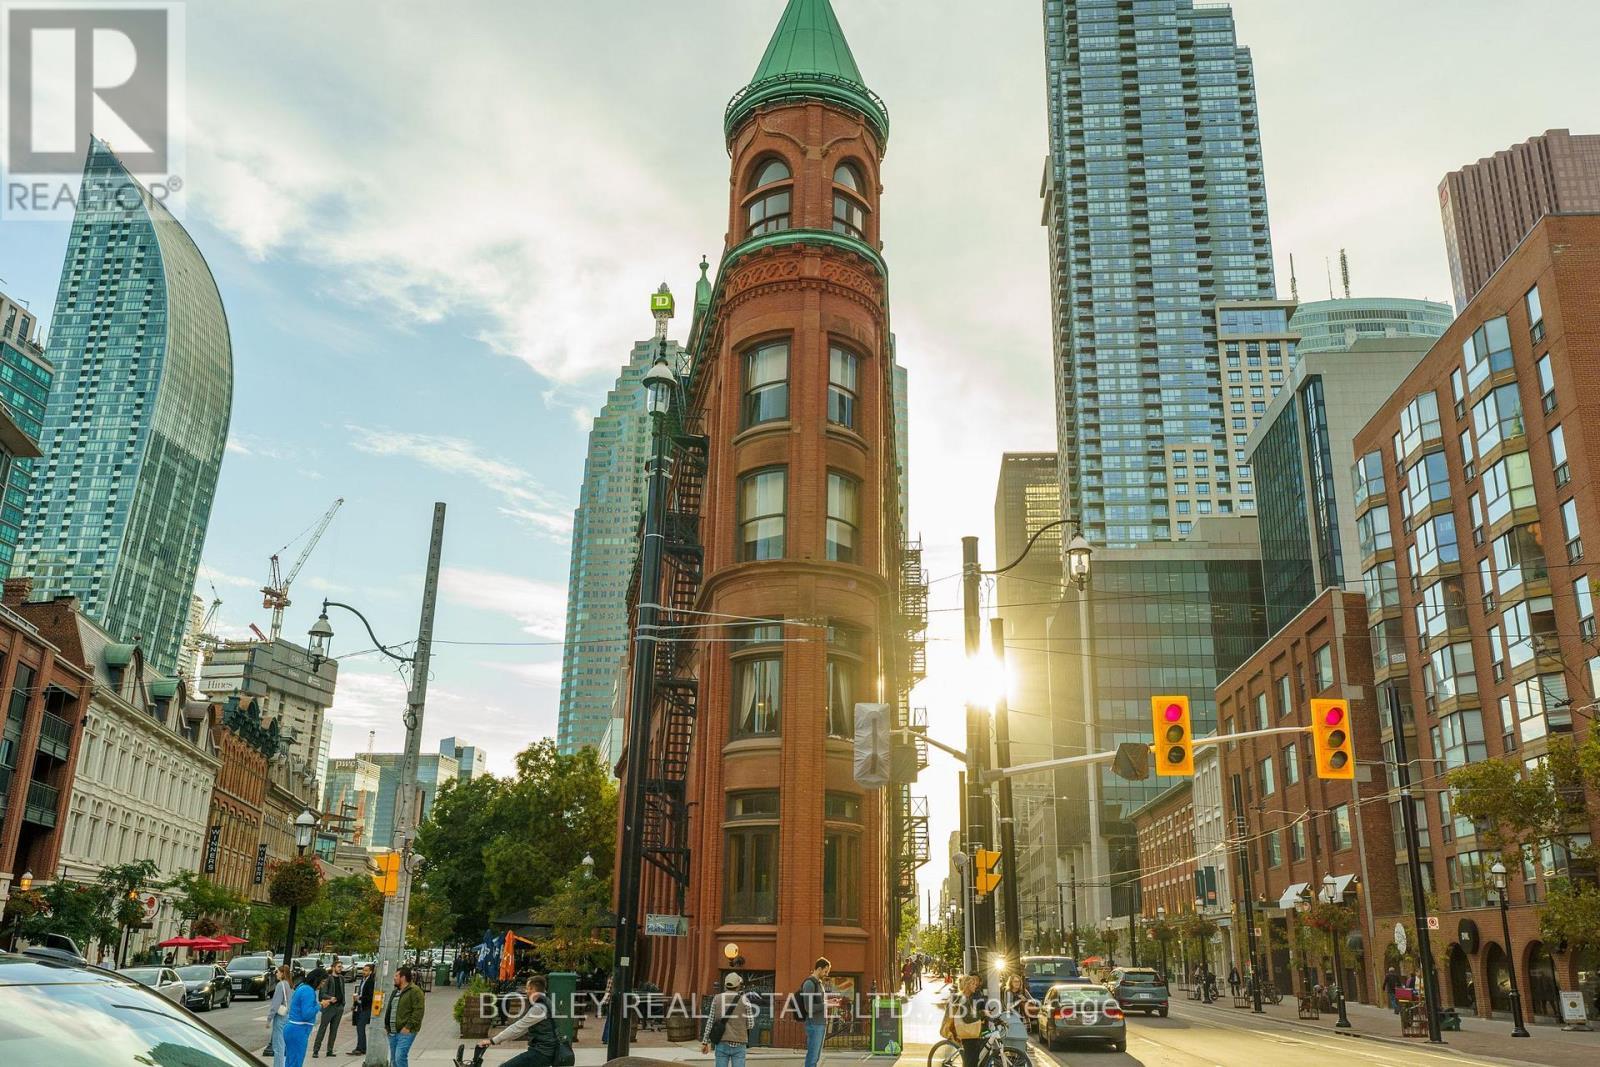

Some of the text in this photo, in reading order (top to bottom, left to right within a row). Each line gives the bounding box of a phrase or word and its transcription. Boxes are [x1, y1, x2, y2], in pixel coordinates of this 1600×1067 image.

[653, 296, 669, 306] TD
[208, 680, 233, 689] Hines
[335, 760, 356, 770] pwc
[208, 829, 220, 870] WINNERS
[256, 847, 266, 881] WINNERS
